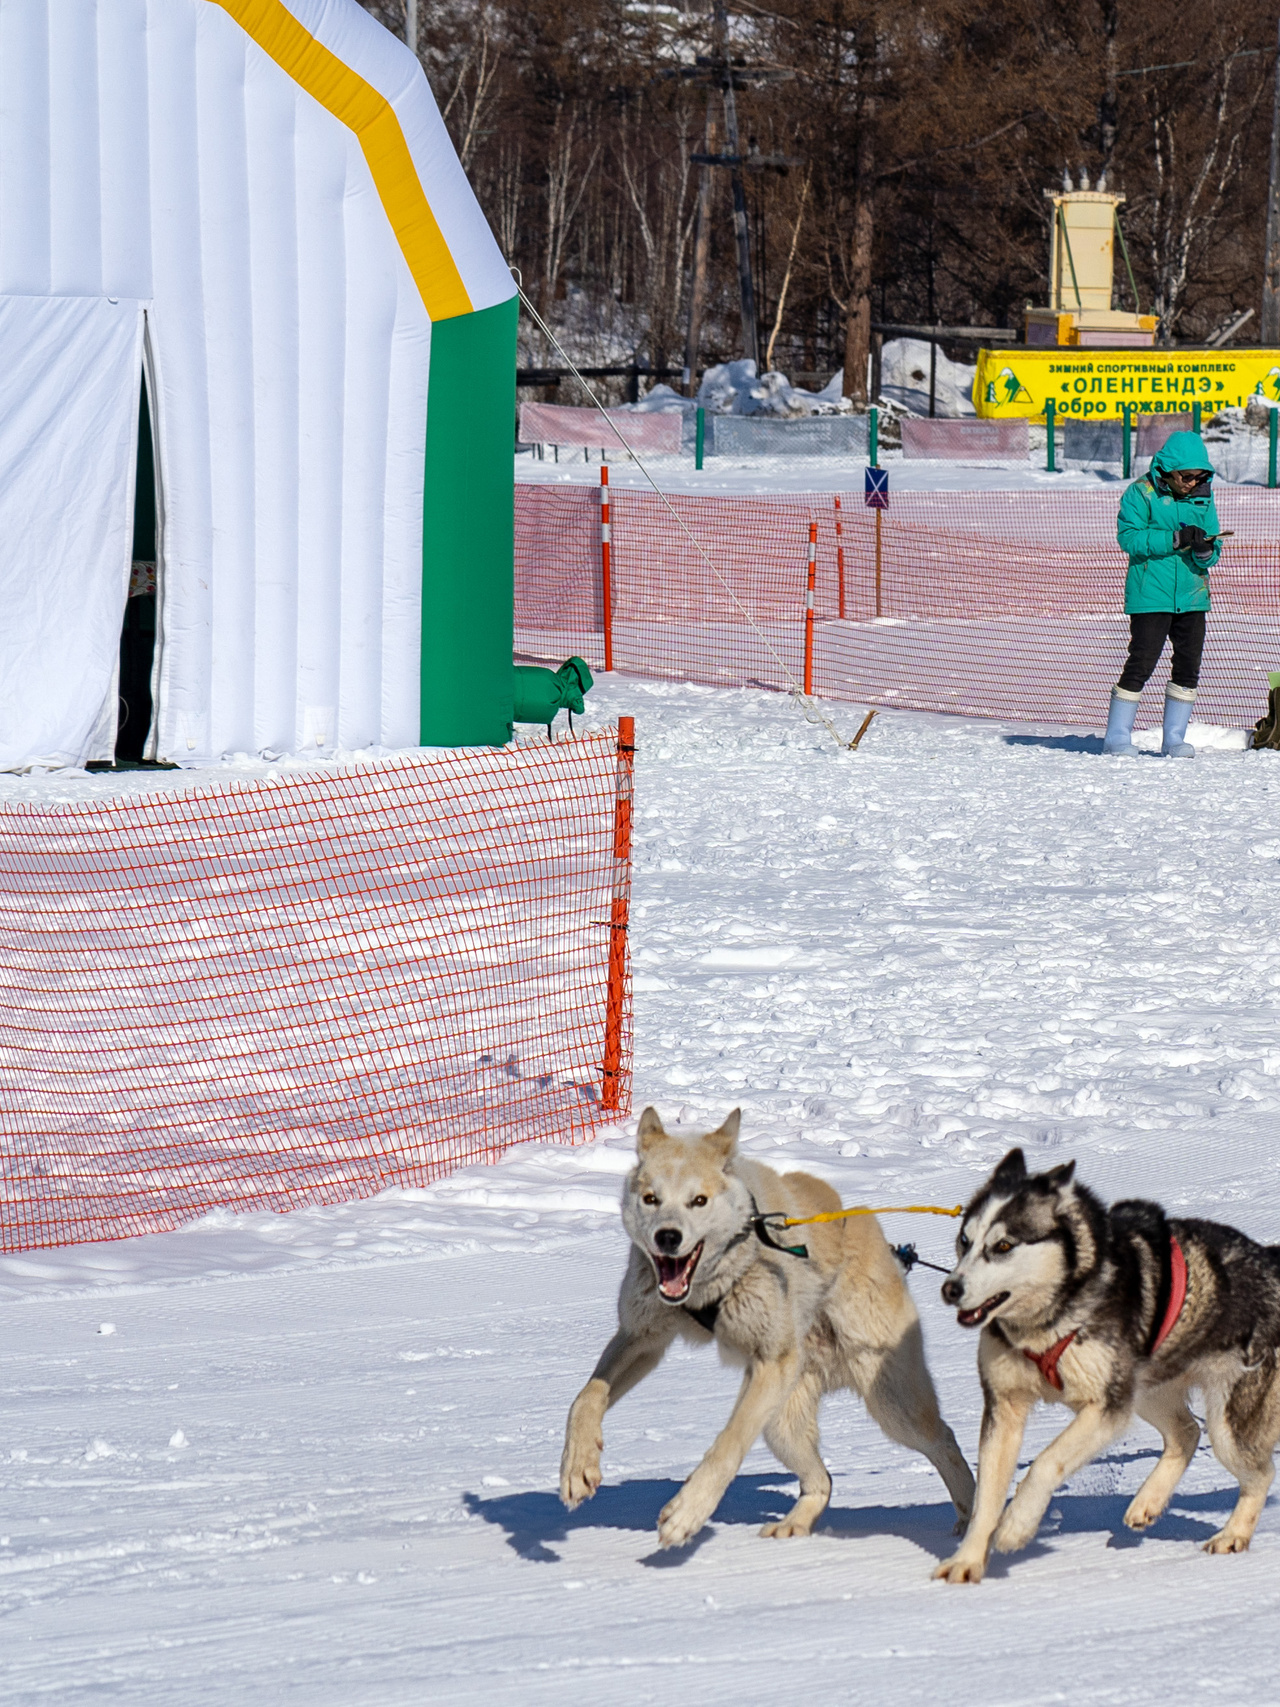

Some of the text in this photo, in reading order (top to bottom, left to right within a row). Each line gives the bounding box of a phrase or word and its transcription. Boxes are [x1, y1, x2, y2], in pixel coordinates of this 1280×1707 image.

[1049, 363, 1236, 374] ЗИМНИЙ СПОРТИВНЫЙ КОМПЛЕКС
[1061, 376, 1225, 394] «ОЛЕНГЕНДЭ»
